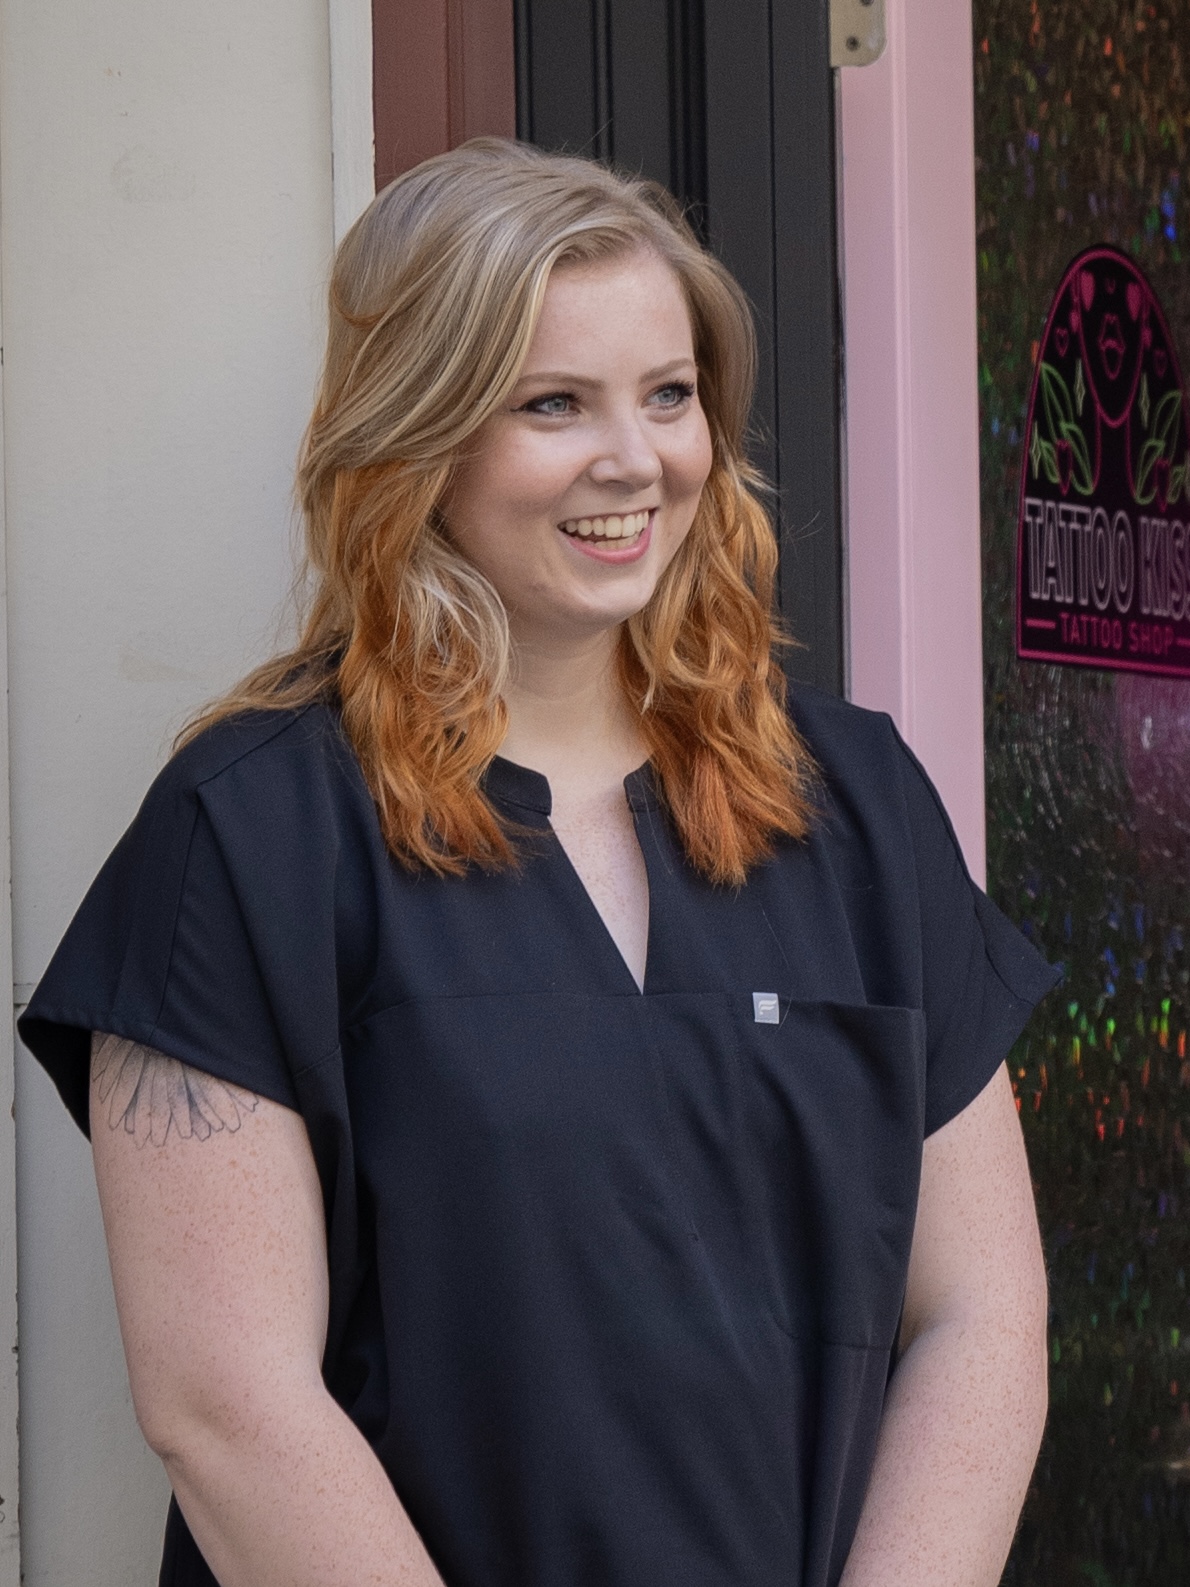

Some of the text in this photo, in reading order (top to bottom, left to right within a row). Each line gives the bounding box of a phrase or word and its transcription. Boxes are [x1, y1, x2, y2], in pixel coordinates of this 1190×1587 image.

[1024, 497, 1135, 614] TATTOO
[1059, 612, 1175, 654] TATTOO SHOP
